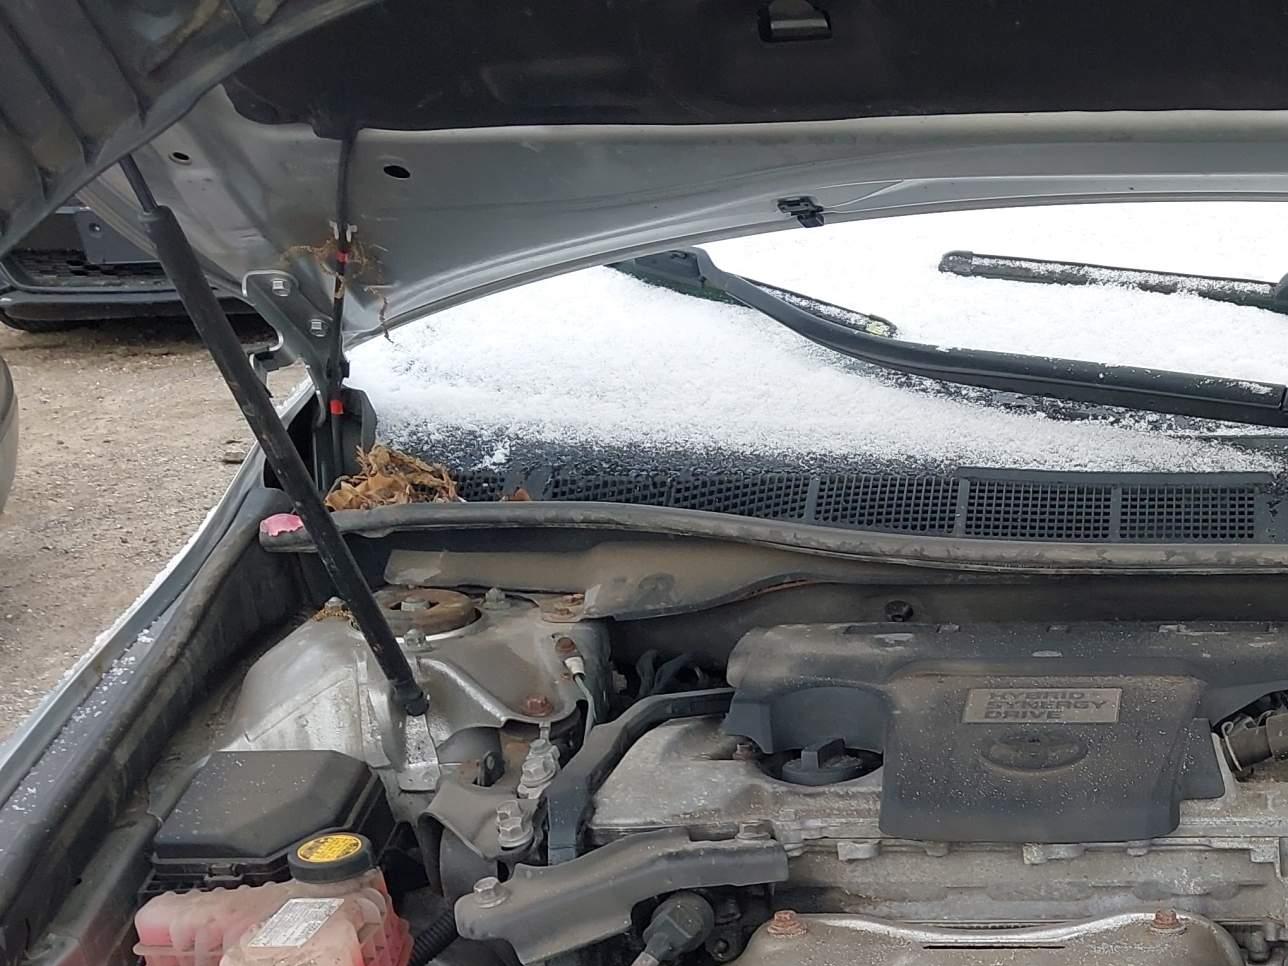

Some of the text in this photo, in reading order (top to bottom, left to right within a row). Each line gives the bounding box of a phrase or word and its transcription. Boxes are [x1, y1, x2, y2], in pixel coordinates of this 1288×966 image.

[989, 691, 1086, 700] HYBRID
[985, 700, 1109, 710] SYNERGY
[984, 710, 1063, 719] DRIVE
